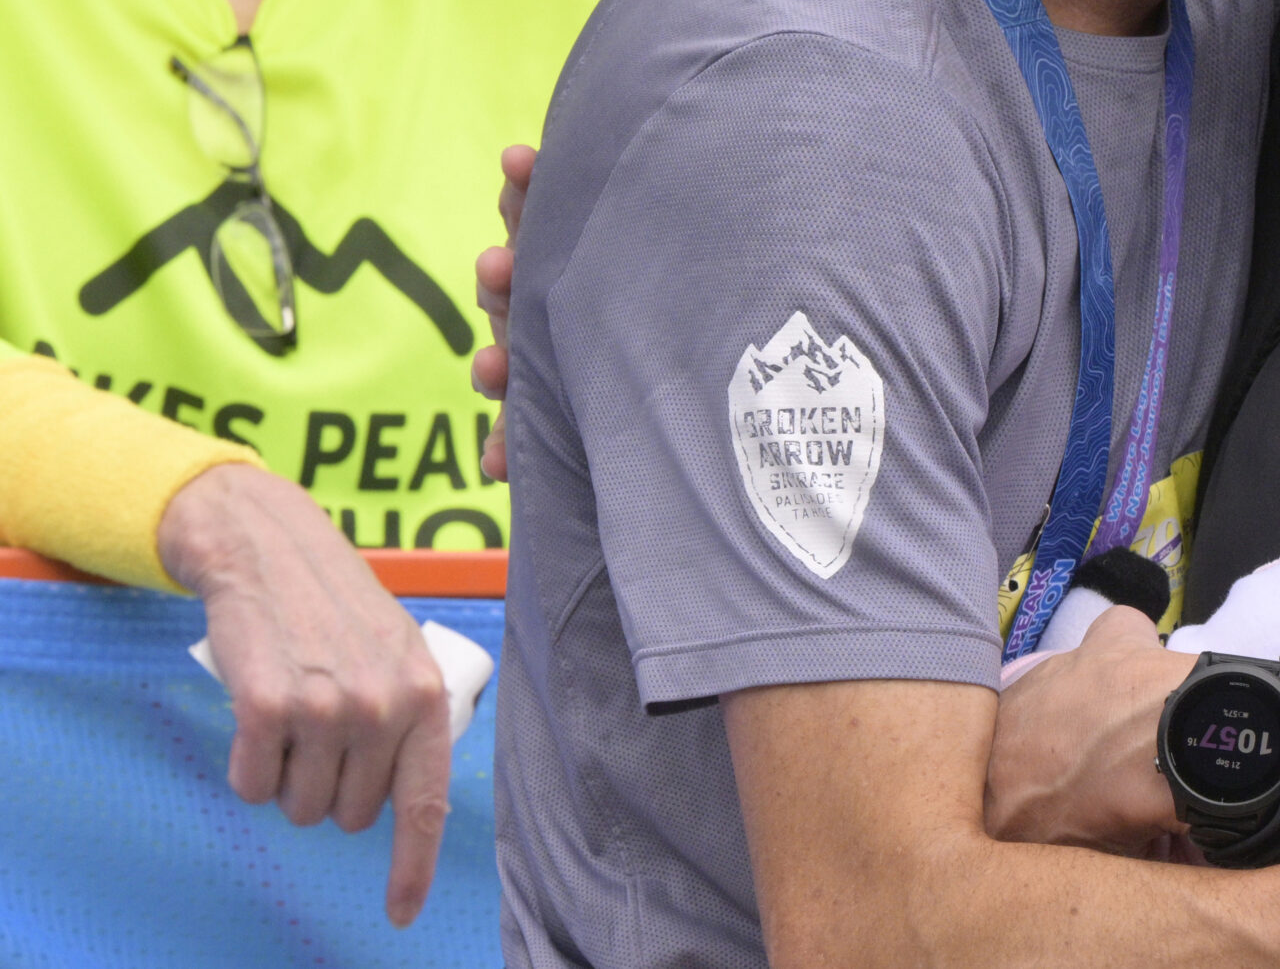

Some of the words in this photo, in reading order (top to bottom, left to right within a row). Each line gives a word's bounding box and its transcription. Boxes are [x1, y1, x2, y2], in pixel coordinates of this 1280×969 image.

[744, 407, 862, 438] BROKEN
[1126, 460, 1147, 518] New
[1140, 347, 1165, 460] Journeys
[759, 439, 854, 469] ARROW
[1107, 441, 1137, 524] Where
[1007, 568, 1052, 653] PEAK
[1187, 737, 1197, 747] 16
[1216, 758, 1230, 768] Sep
[1232, 761, 1241, 769] 21
